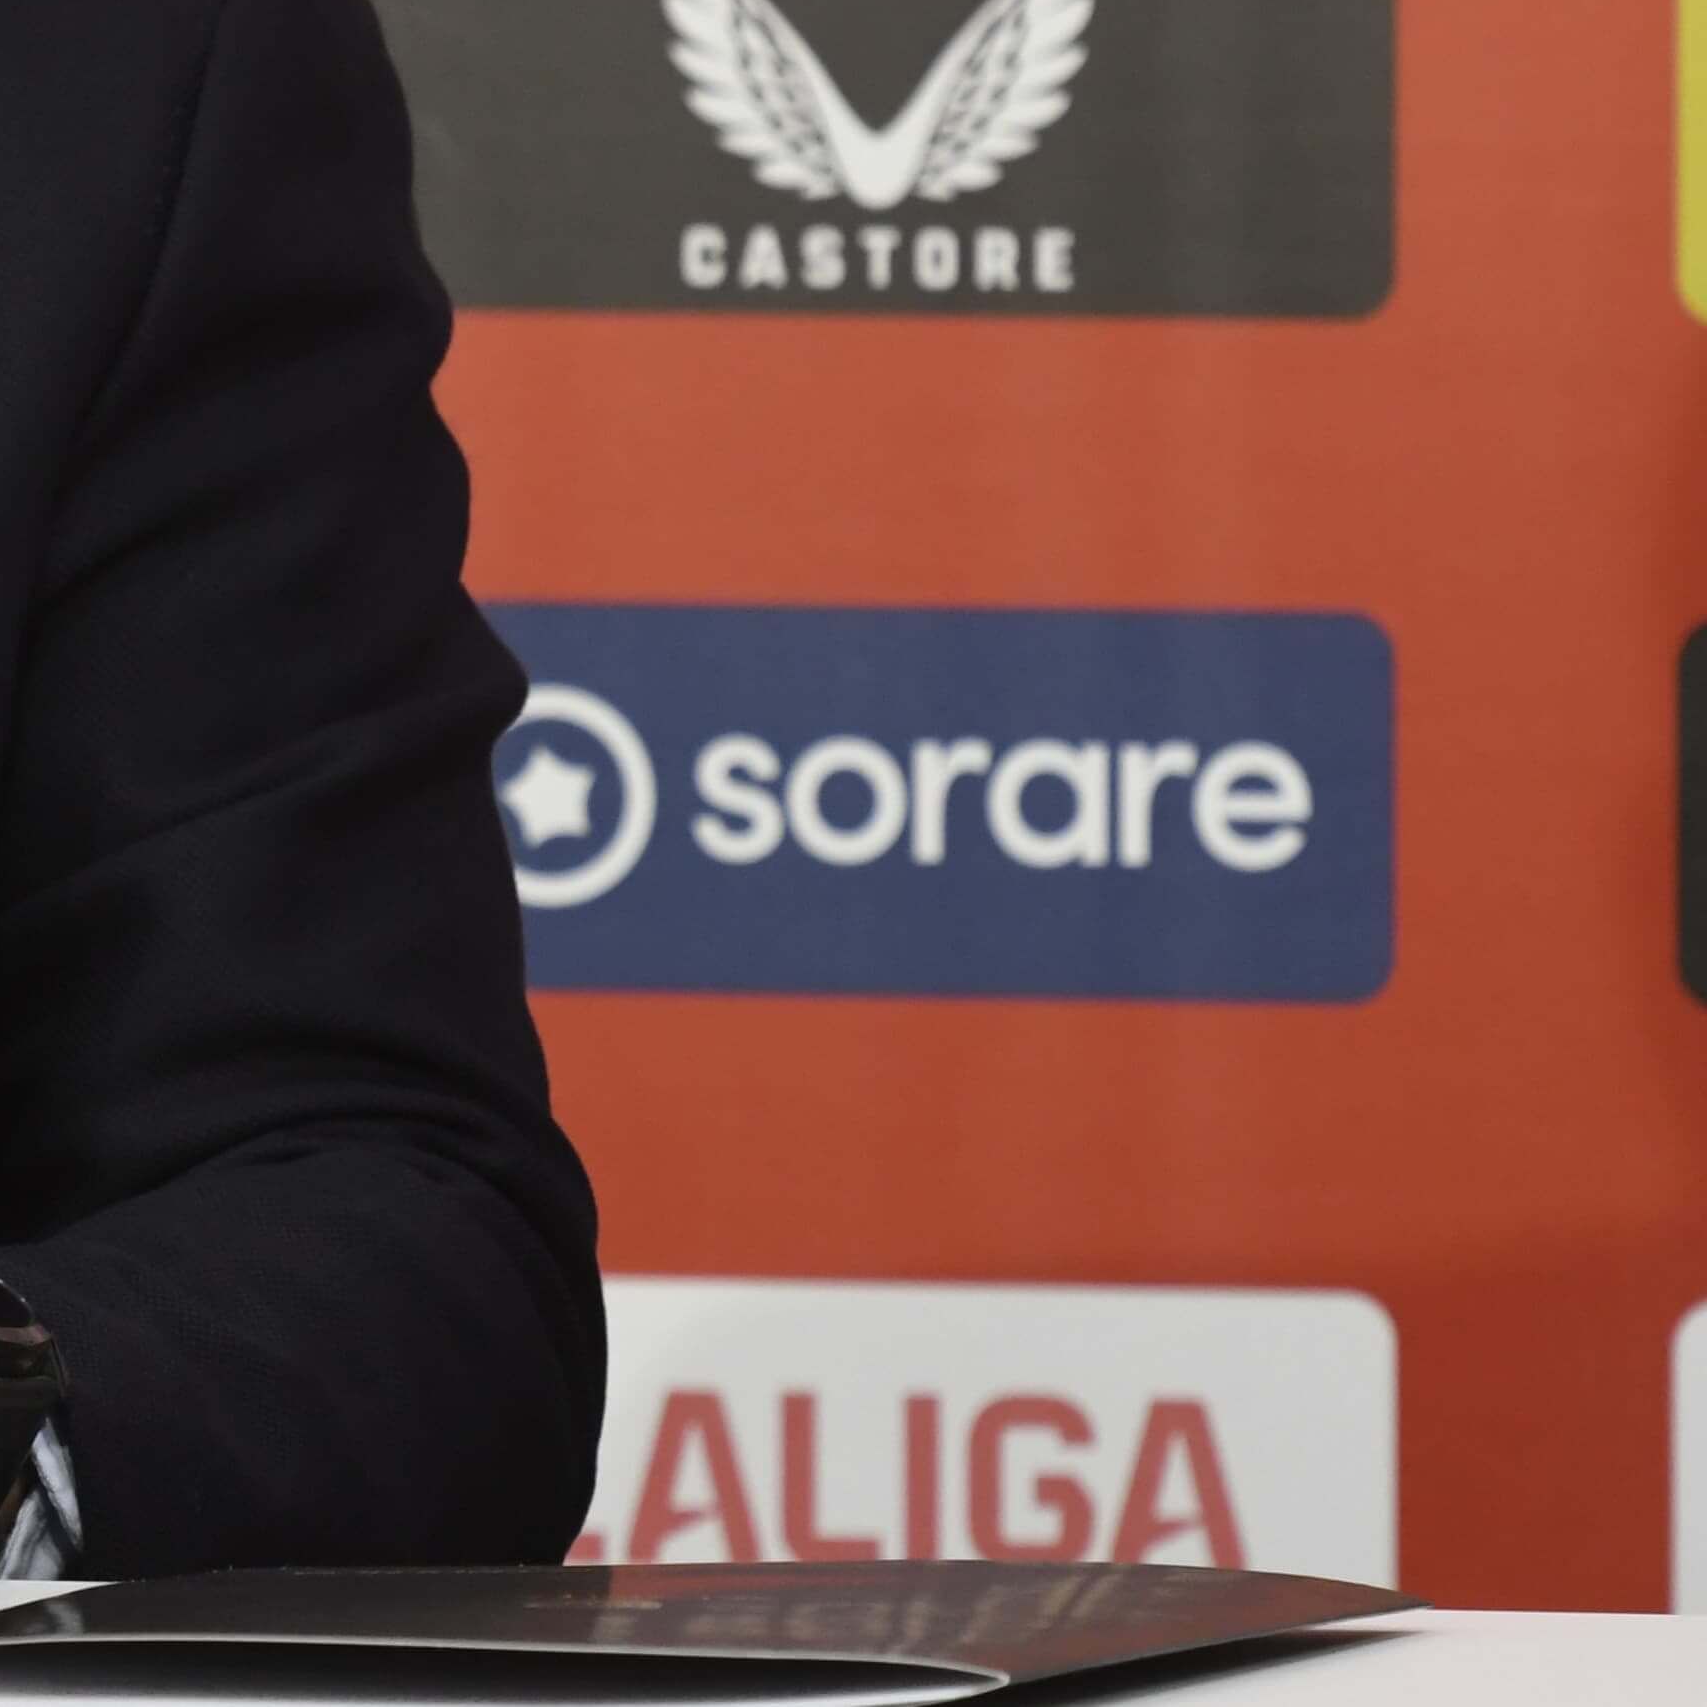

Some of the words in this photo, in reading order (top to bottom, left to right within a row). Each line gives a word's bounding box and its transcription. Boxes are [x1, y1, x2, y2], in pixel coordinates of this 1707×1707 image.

[680, 224, 1075, 292] CASTORE
[692, 735, 1315, 872] sorare
[564, 1389, 1251, 1566] ALIGA
